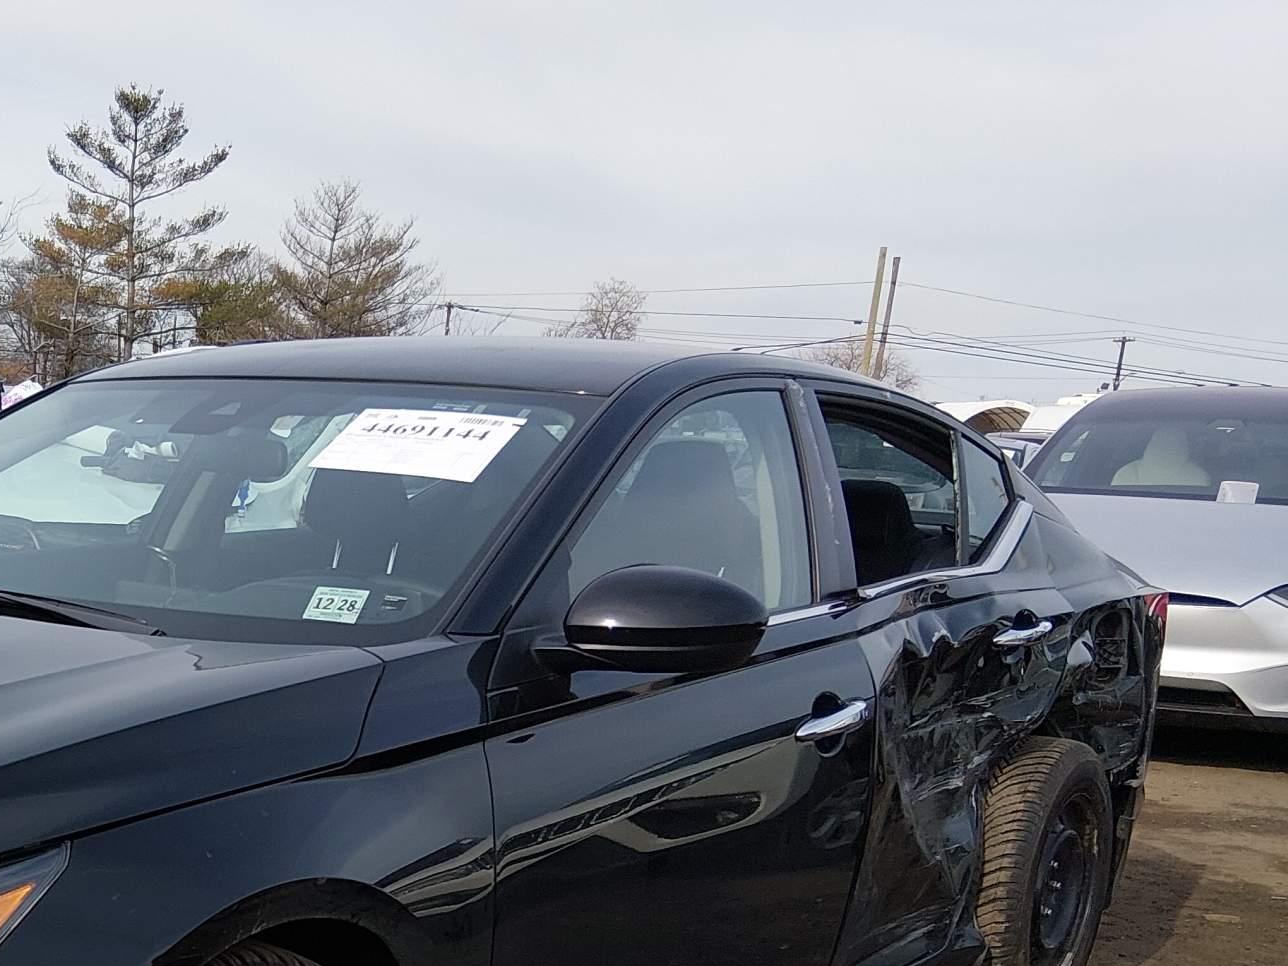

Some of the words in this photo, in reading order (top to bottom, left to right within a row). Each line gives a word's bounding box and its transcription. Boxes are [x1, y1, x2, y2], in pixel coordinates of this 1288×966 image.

[361, 422, 492, 442] 44691144
[312, 596, 335, 610] 12
[336, 599, 358, 612] 28
